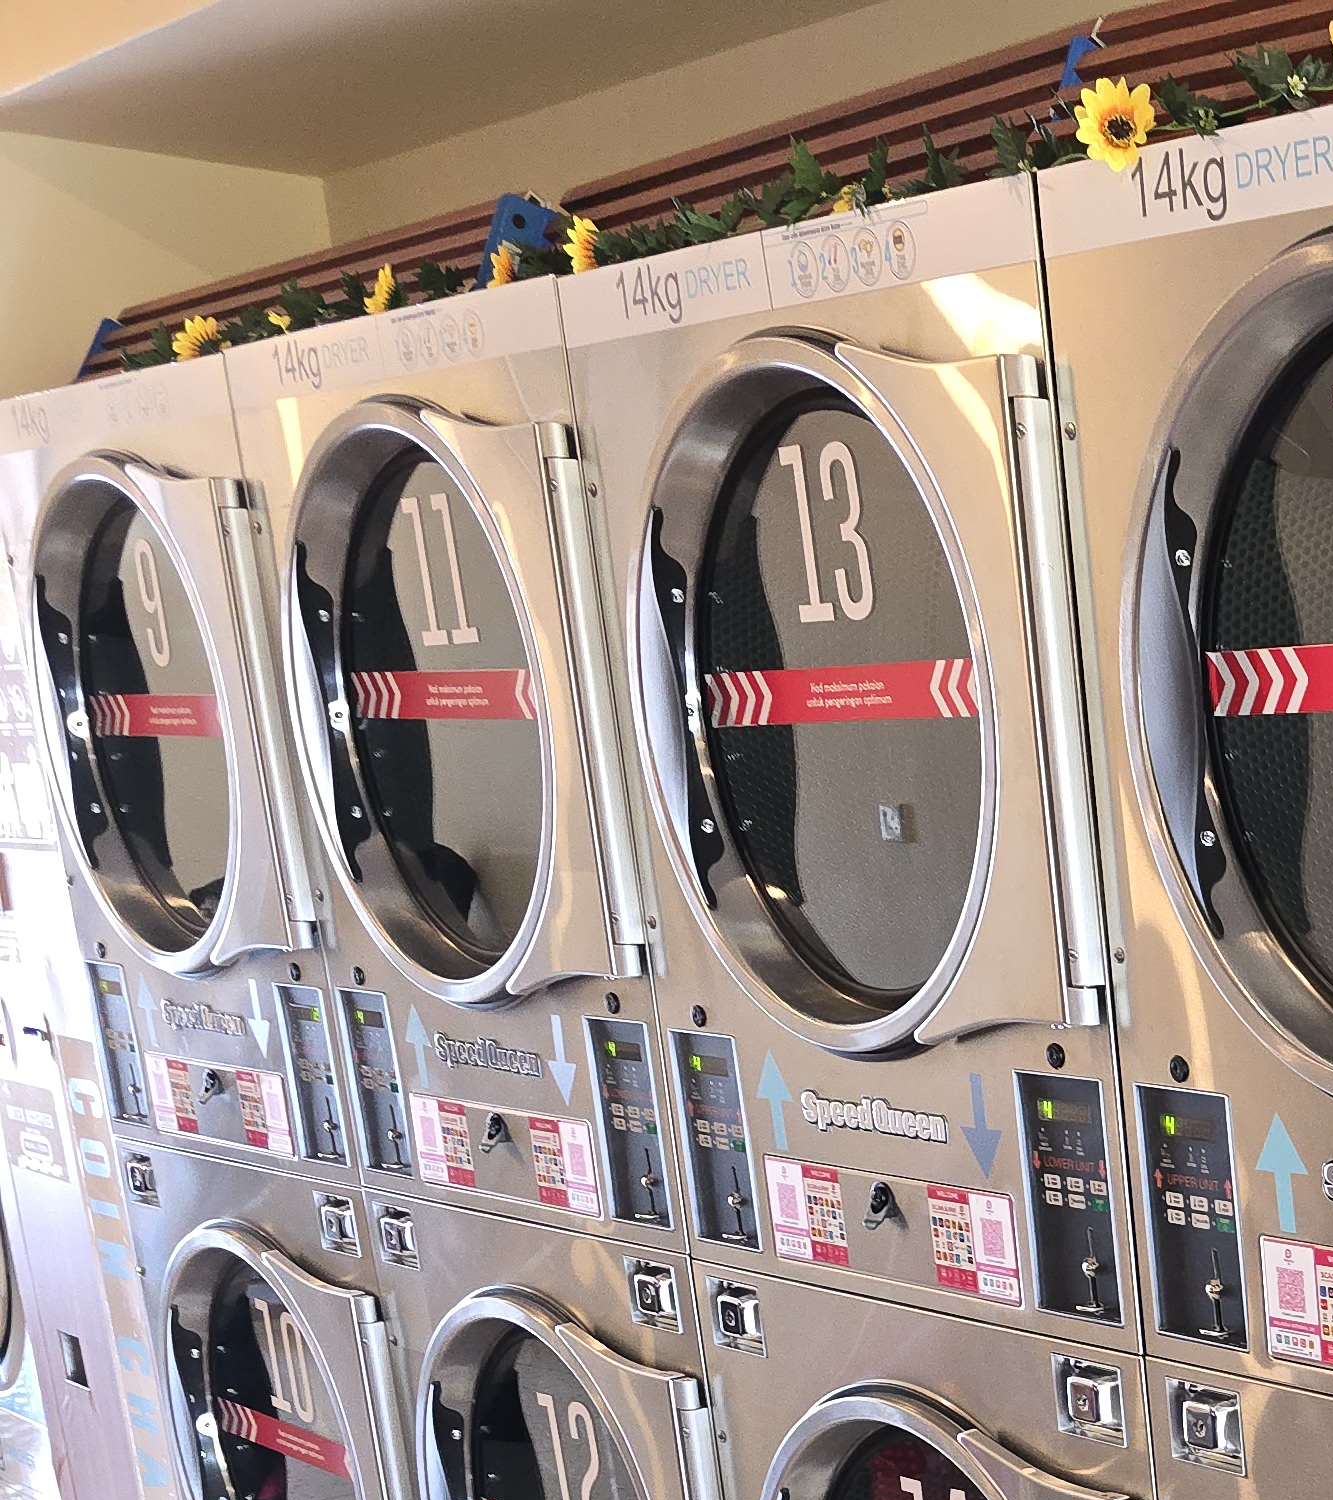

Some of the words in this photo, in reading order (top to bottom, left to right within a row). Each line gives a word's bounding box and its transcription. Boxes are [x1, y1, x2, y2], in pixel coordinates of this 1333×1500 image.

[1131, 149, 1228, 220] 14kg
[1234, 135, 1333, 191] DRYER
[616, 263, 683, 323] 14kg
[685, 257, 751, 299] DRYER
[272, 340, 322, 389] 14kg
[323, 336, 370, 370] DRYER
[400, 492, 480, 647] 11
[778, 441, 874, 623] 13
[134, 538, 170, 668] 9
[800, 1088, 874, 1132] Speed
[873, 1097, 949, 1144] Queen
[1167, 1173, 1196, 1189] UPPER
[253, 1297, 315, 1423] 10
